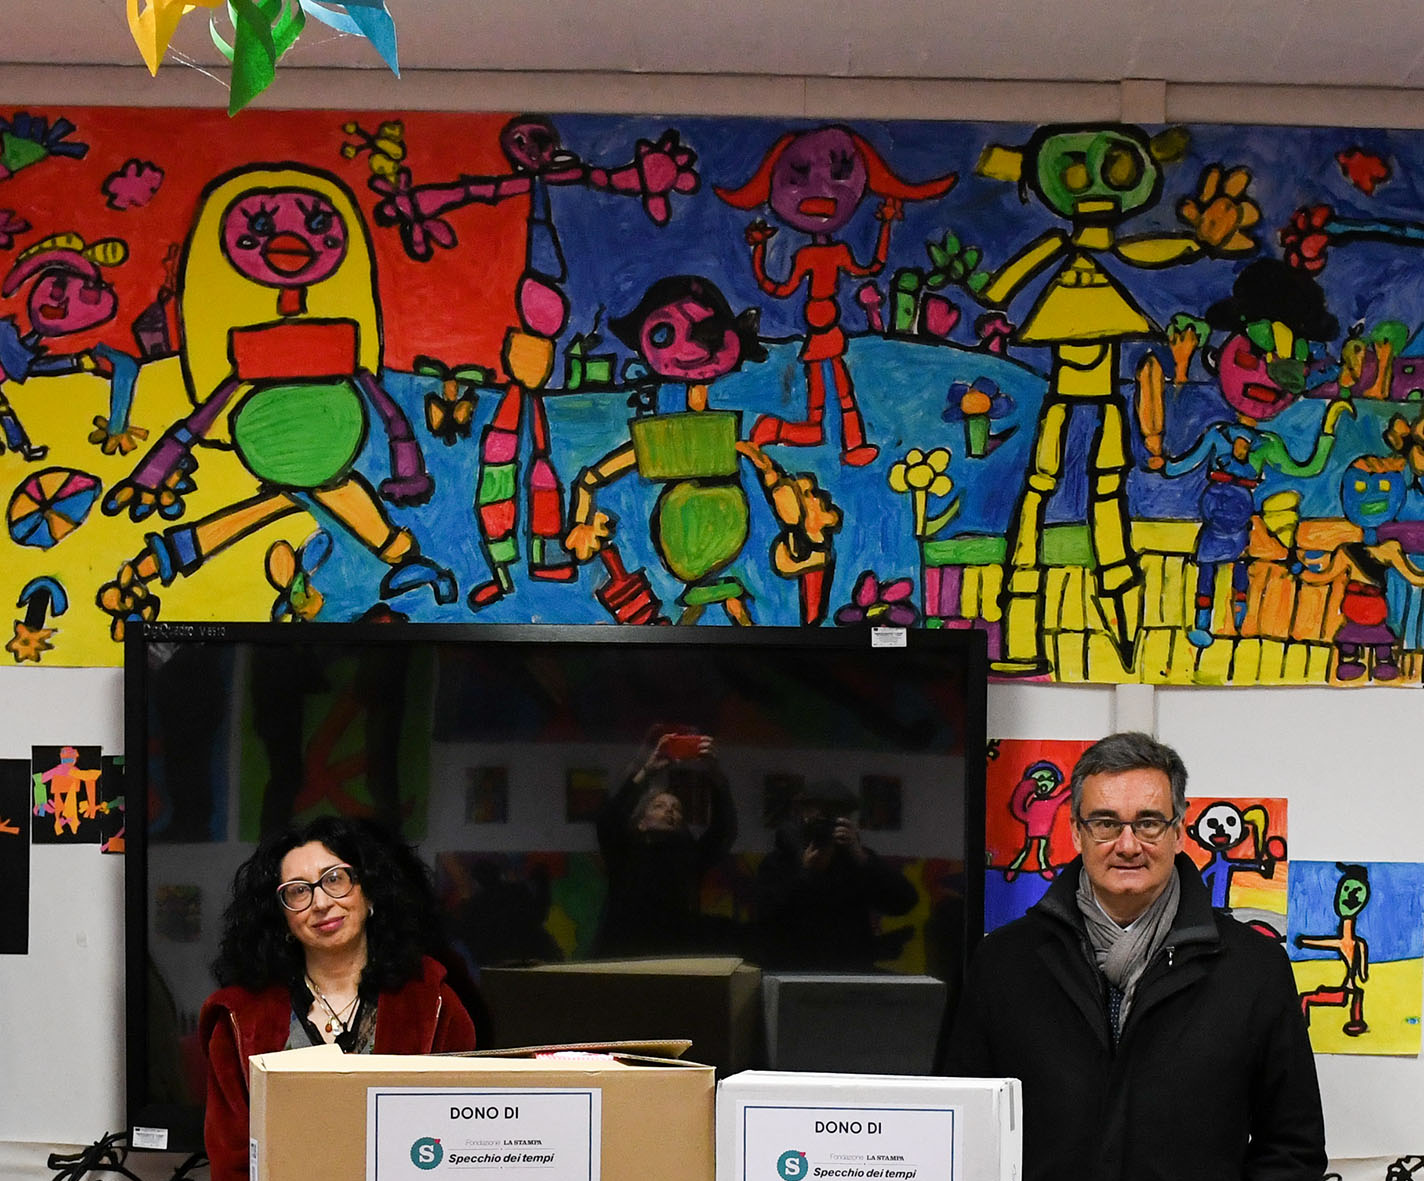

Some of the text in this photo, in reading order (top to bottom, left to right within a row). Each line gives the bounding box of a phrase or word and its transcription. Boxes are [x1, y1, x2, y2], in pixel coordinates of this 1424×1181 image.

[450, 1107, 519, 1119] DONO DI
[815, 1121, 882, 1134] DONO DI
[419, 1145, 435, 1162] S
[449, 1153, 554, 1164] Specchio dei tempi
[785, 1158, 800, 1175] S
[813, 1168, 917, 1179] Specchio dei tempi
